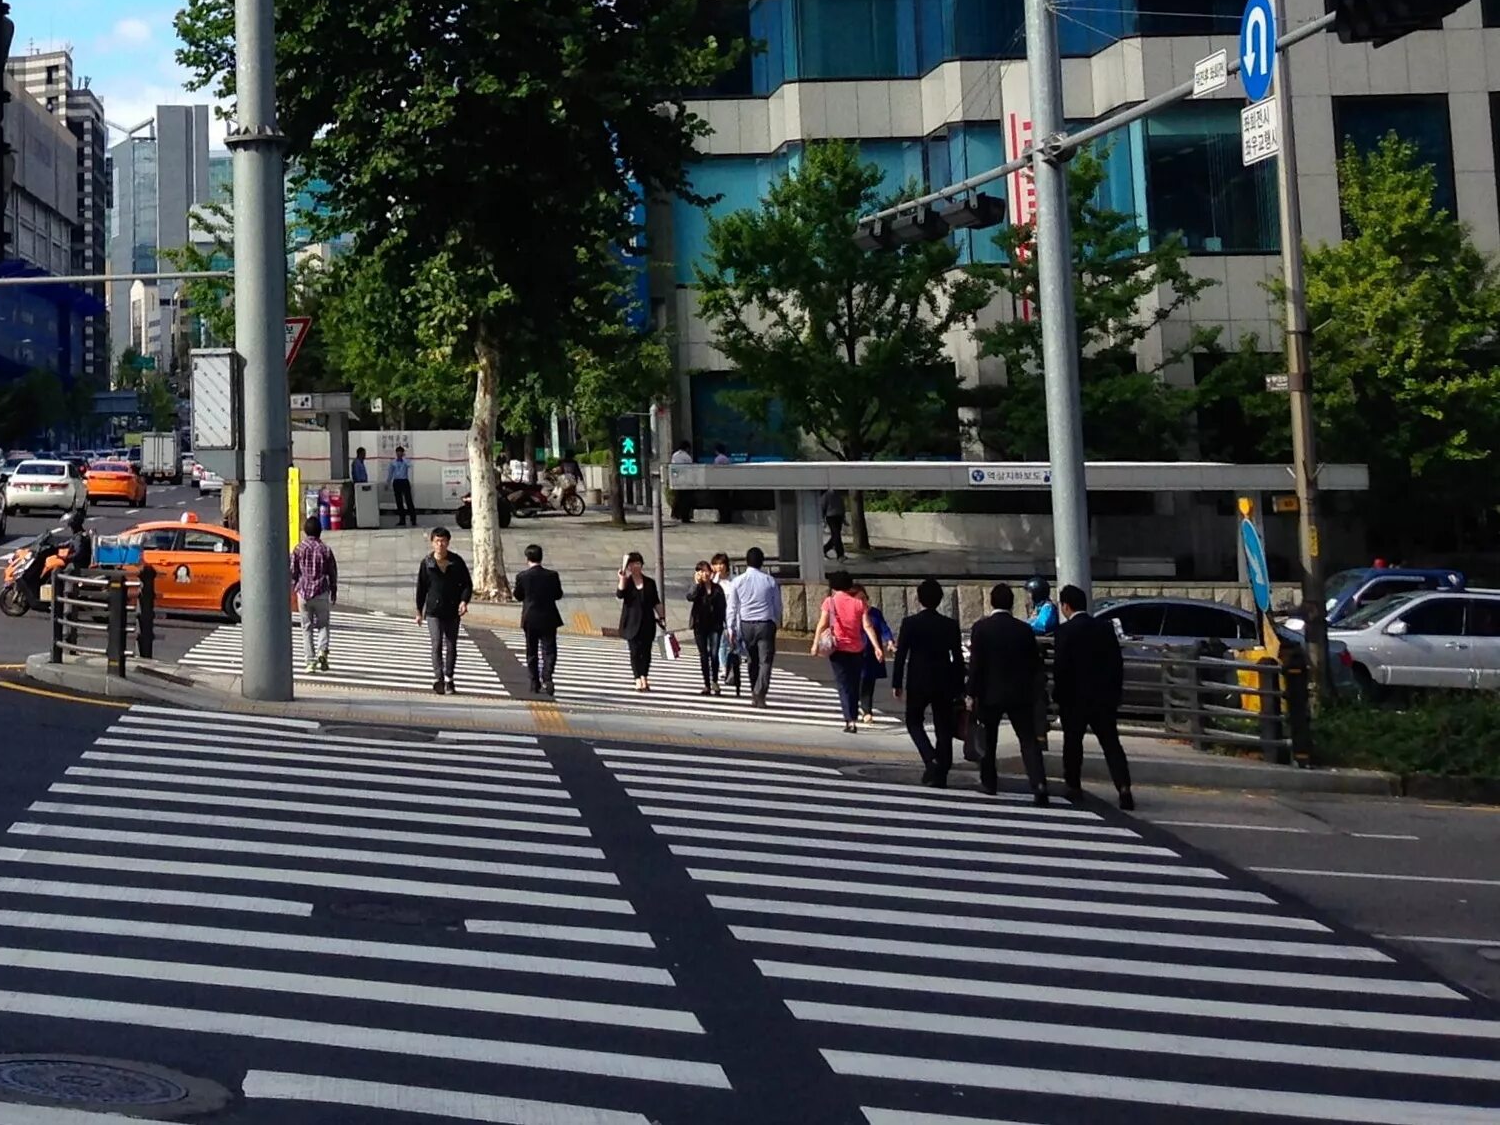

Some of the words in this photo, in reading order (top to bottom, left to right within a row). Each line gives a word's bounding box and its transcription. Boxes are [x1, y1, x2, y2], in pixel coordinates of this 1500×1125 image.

[1243, 106, 1270, 133] 좌회전시
[620, 458, 638, 475] 26
[987, 470, 1042, 481] 역삼지하보도
